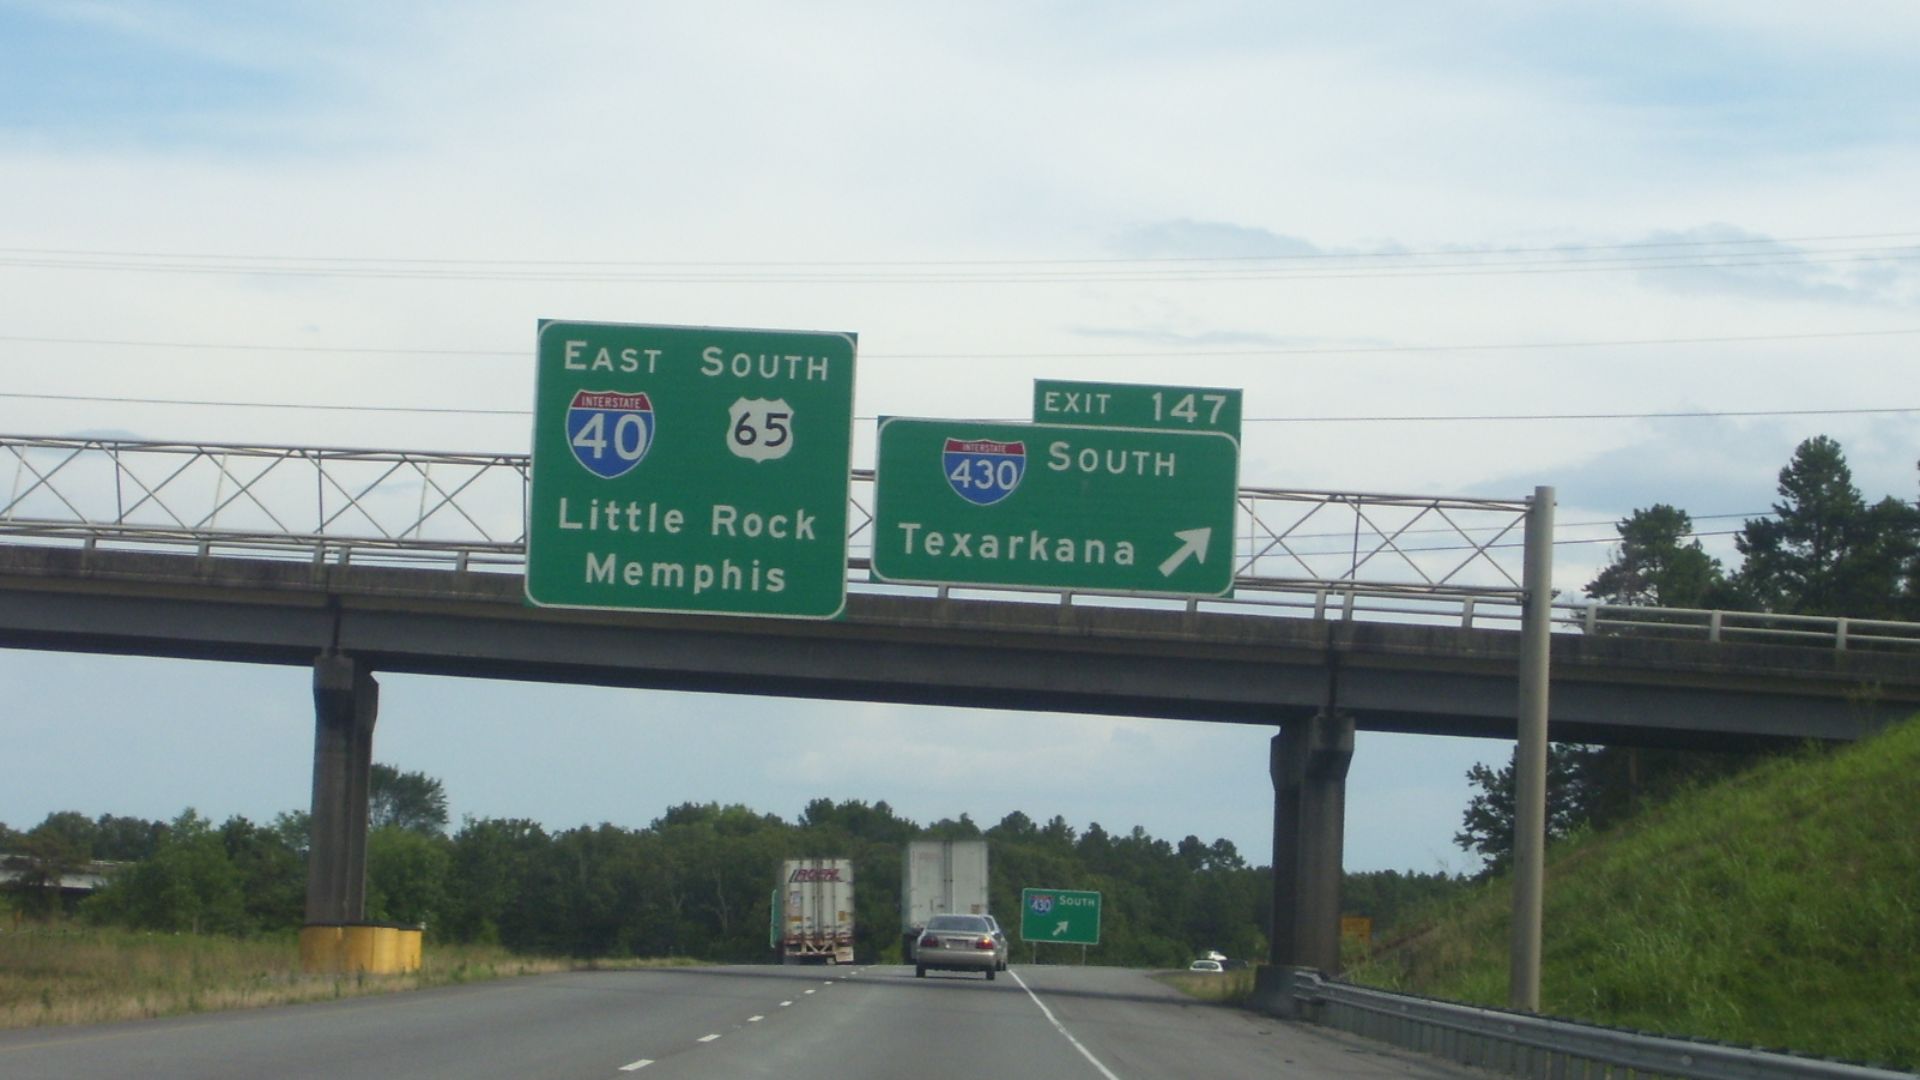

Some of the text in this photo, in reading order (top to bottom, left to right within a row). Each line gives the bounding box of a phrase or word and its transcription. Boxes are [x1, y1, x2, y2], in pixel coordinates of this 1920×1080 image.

[564, 340, 828, 381] EAST SOUTH
[581, 395, 641, 409] INTERSTATE
[1044, 391, 1227, 424] EXIT 147
[572, 412, 648, 460] 40
[734, 411, 789, 447] 65
[962, 443, 1007, 453] INTERSTATE
[1047, 441, 1175, 477] SOUTH
[950, 458, 1018, 490] 430
[559, 497, 816, 540] Little Rock
[897, 522, 1135, 566] Texarkana
[585, 552, 787, 595] Memphis
[1031, 899, 1051, 912] 430
[1059, 895, 1095, 907] SOUTH
